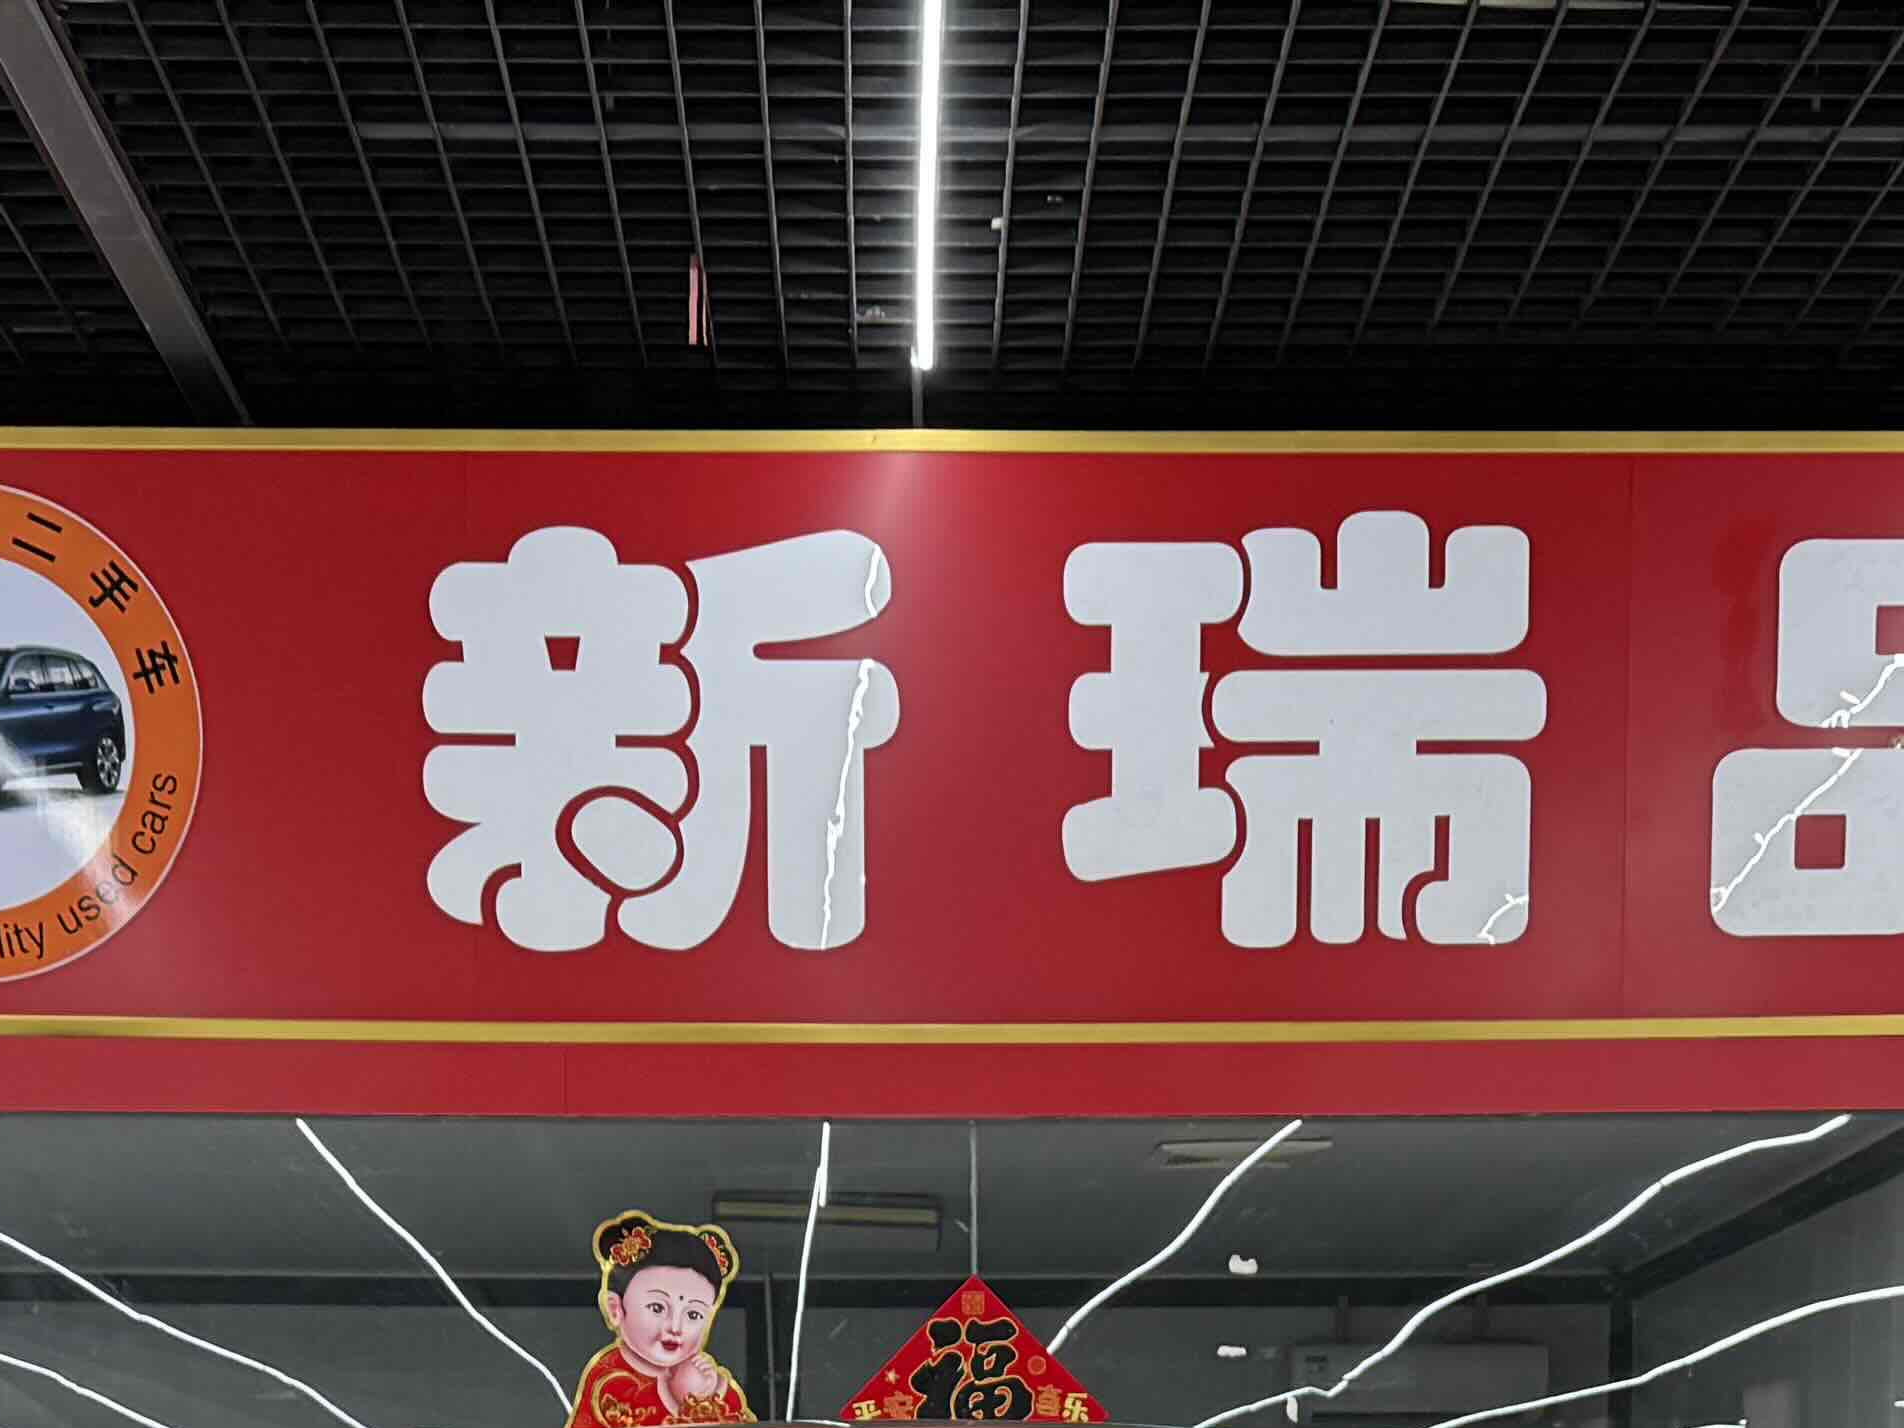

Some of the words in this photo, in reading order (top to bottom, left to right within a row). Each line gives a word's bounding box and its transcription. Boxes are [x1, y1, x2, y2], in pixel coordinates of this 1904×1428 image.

[56, 853, 139, 935] used
[130, 771, 179, 856] cars
[909, 1317, 1034, 1420] 福
